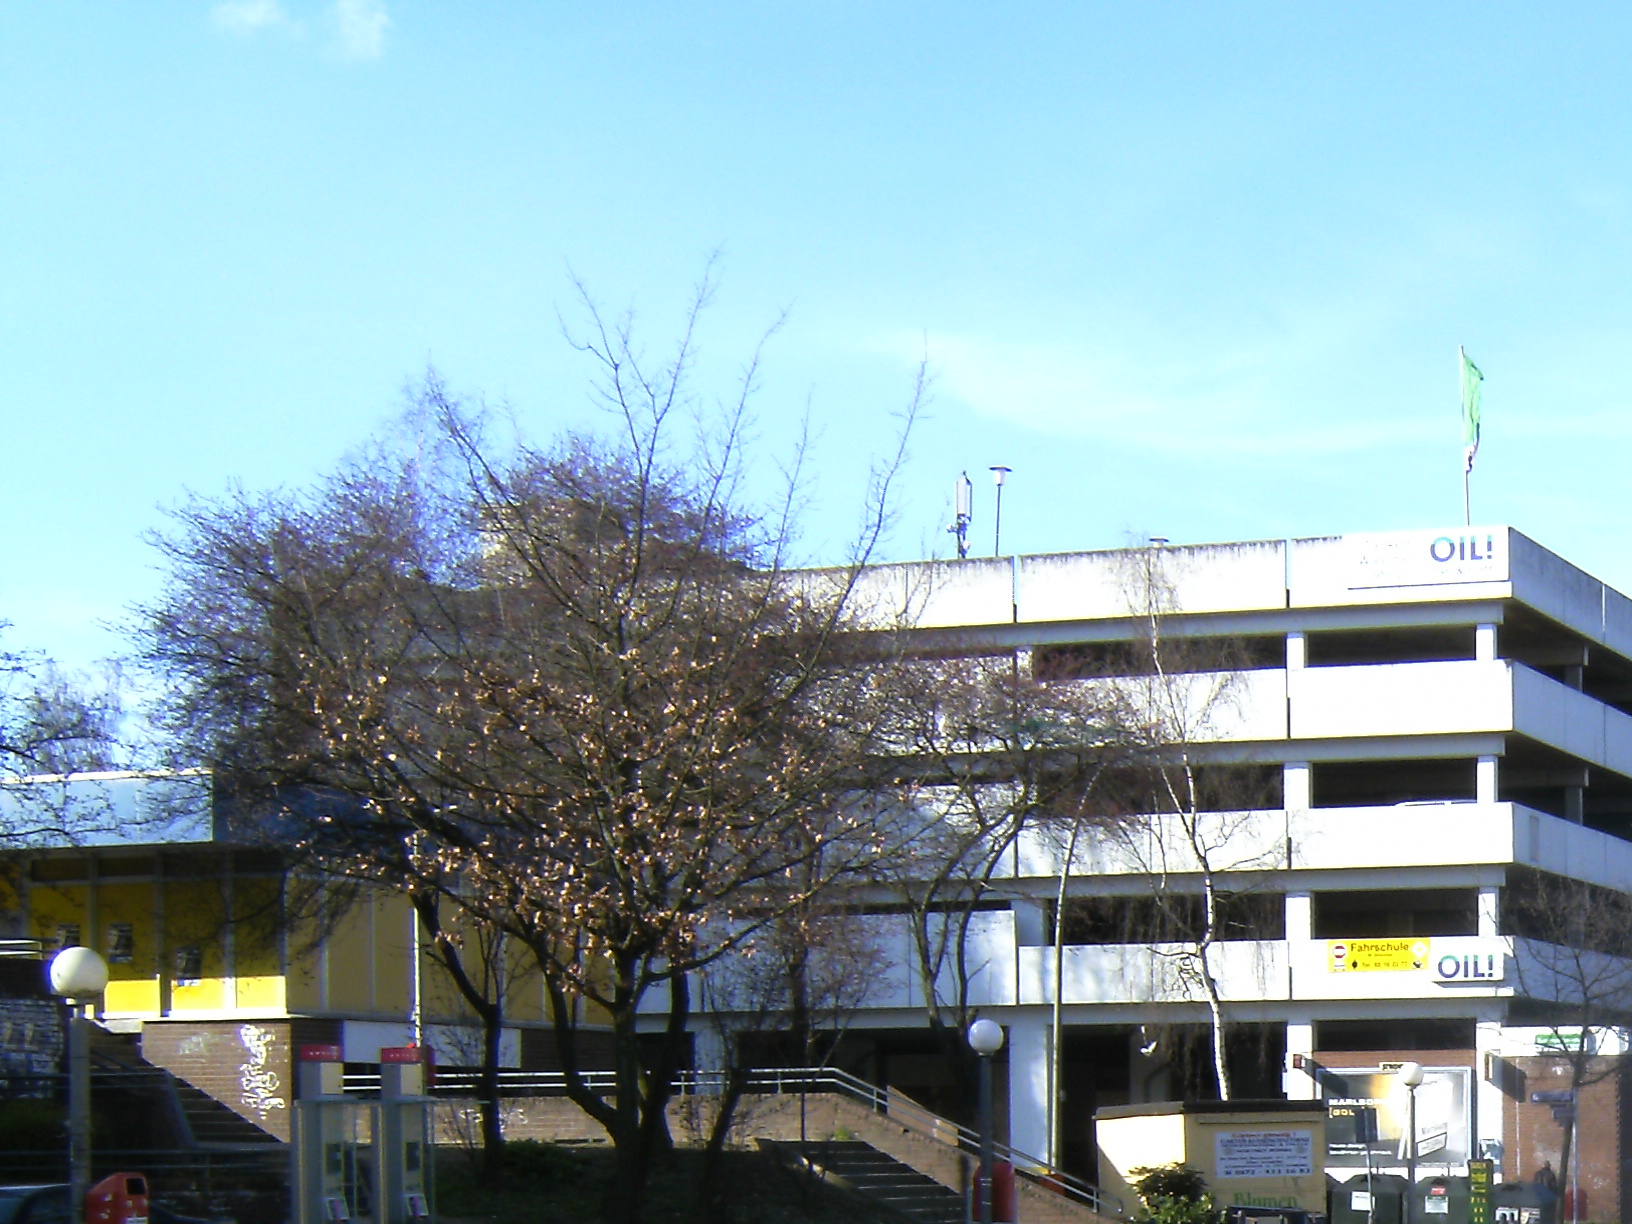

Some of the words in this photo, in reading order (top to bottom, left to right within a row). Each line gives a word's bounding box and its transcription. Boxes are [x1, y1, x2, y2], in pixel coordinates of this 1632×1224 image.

[1430, 534, 1493, 563] OIL!
[1350, 942, 1410, 953] Fahrschule
[1438, 954, 1494, 979] OIL!
